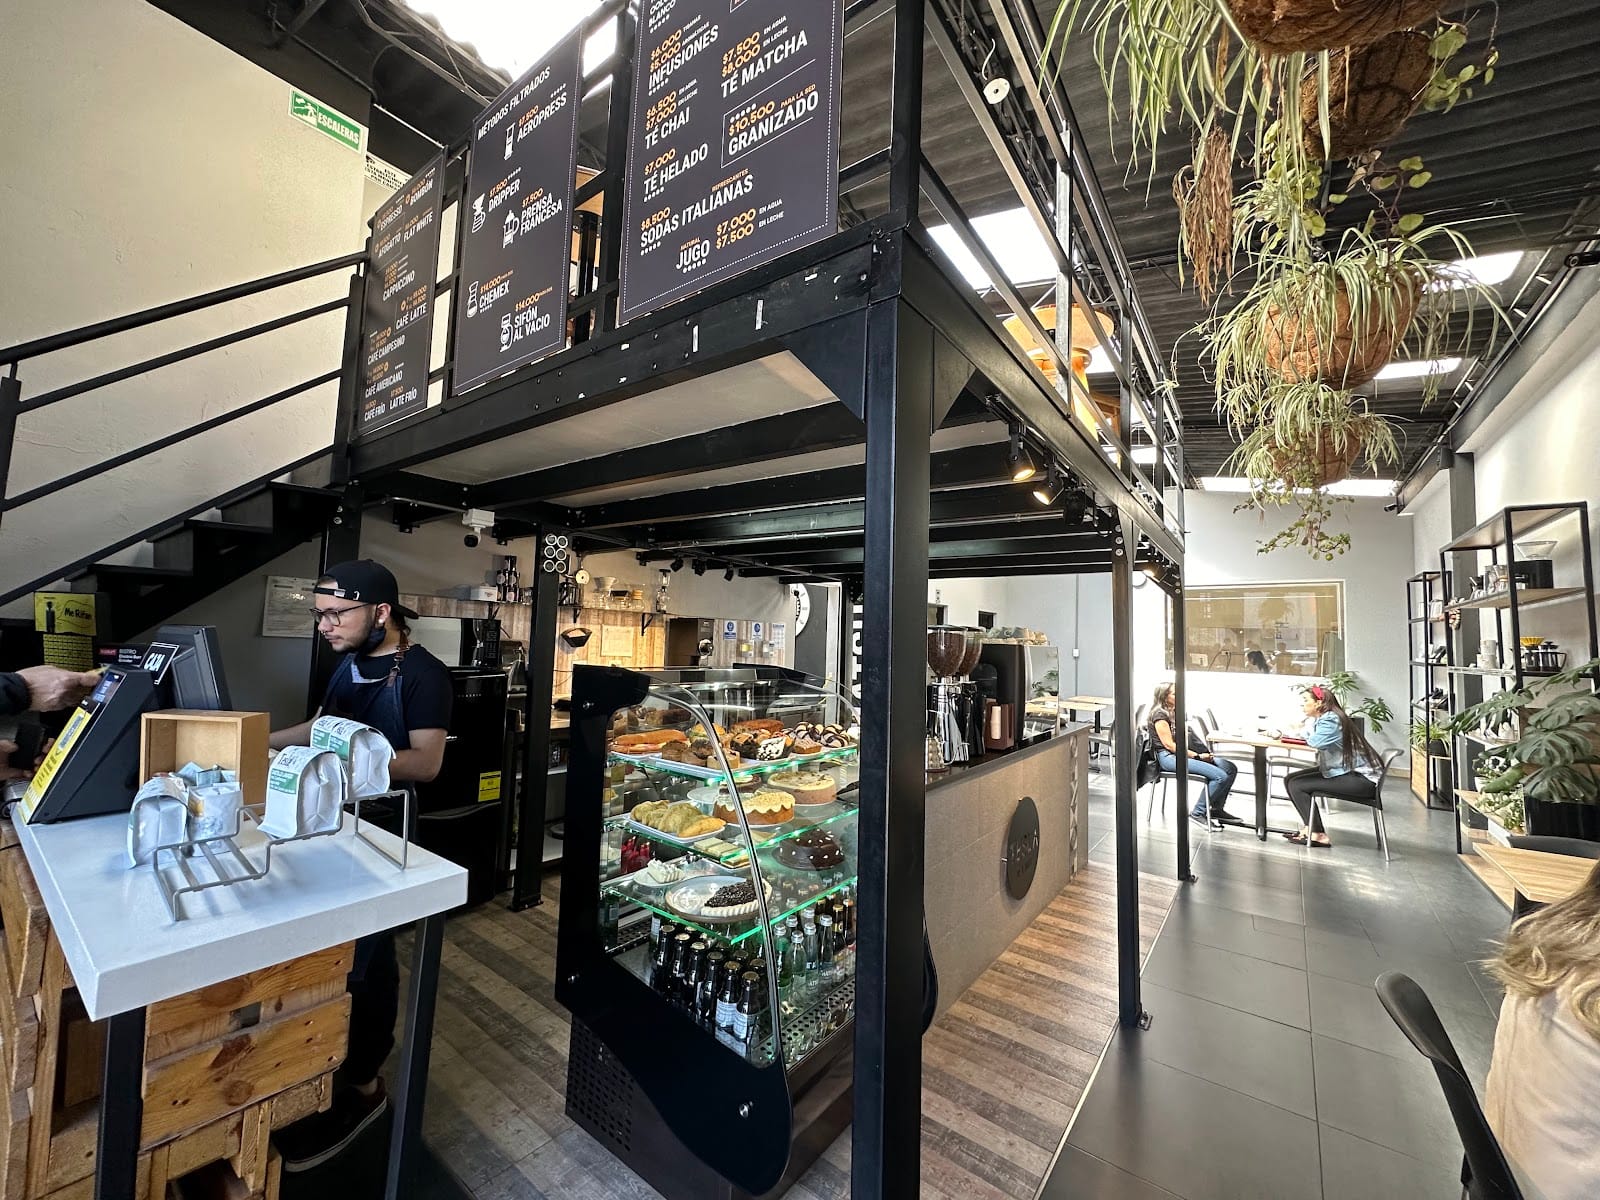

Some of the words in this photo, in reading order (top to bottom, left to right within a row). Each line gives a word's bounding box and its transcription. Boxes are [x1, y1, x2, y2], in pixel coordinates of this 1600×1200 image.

[648, 0, 677, 27] BLANCO
[649, 25, 719, 90] INFUSIONES
[721, 70, 738, 98] TÉ
[741, 30, 808, 86] MATCHA
[723, 32, 760, 64] $7.500
[477, 103, 509, 140] MÉTODOS
[509, 66, 551, 111] FILTRADOS
[517, 92, 567, 142] AEROPRESS
[729, 101, 775, 136] $10.500
[318, 114, 360, 144] ESCALERAS
[645, 126, 659, 150] TÉ
[661, 106, 690, 139] CHAI
[728, 90, 819, 155] GRANIZADO
[644, 171, 658, 195] TÉ
[660, 144, 709, 186] HELADO
[645, 149, 676, 176] $7.000
[488, 178, 520, 212] DRIPPER
[521, 192, 553, 223] PRENSA
[640, 214, 679, 247] SODAS
[682, 174, 754, 226] ITALIANAS
[520, 199, 563, 236] FRANCESA
[716, 208, 757, 236] $7.000
[716, 223, 754, 249] $7.500
[676, 239, 710, 269] JUGO
[410, 302, 427, 317] LATTE
[479, 279, 510, 308] CHEMEX
[513, 326, 524, 342] AL
[525, 313, 550, 337] VACIO
[514, 305, 538, 328] SIFÓN
